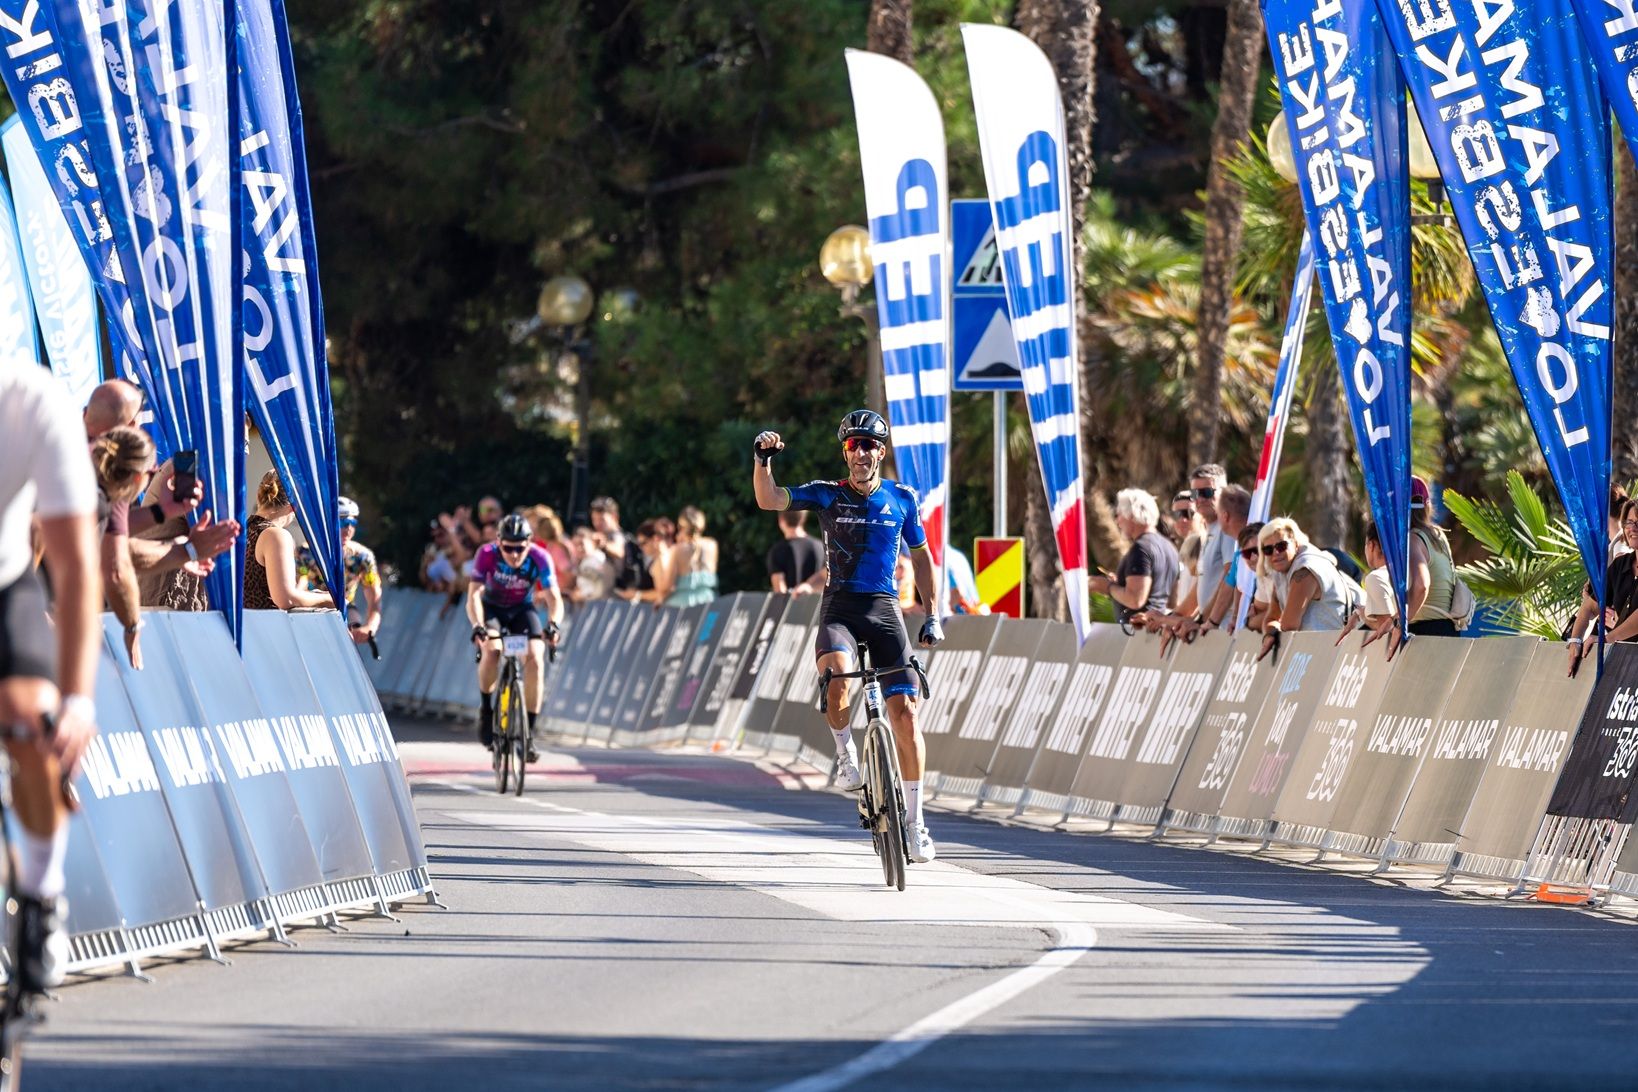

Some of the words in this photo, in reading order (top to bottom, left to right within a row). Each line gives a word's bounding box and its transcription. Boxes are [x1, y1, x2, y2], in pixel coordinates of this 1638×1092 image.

[835, 516, 897, 528] BULLS
[1216, 651, 1259, 703] Istria
[1324, 653, 1369, 709] Istria
[1367, 713, 1432, 758] VALAMAR
[1433, 719, 1500, 761] VALAMAR
[1496, 725, 1568, 773] VALAMAR
